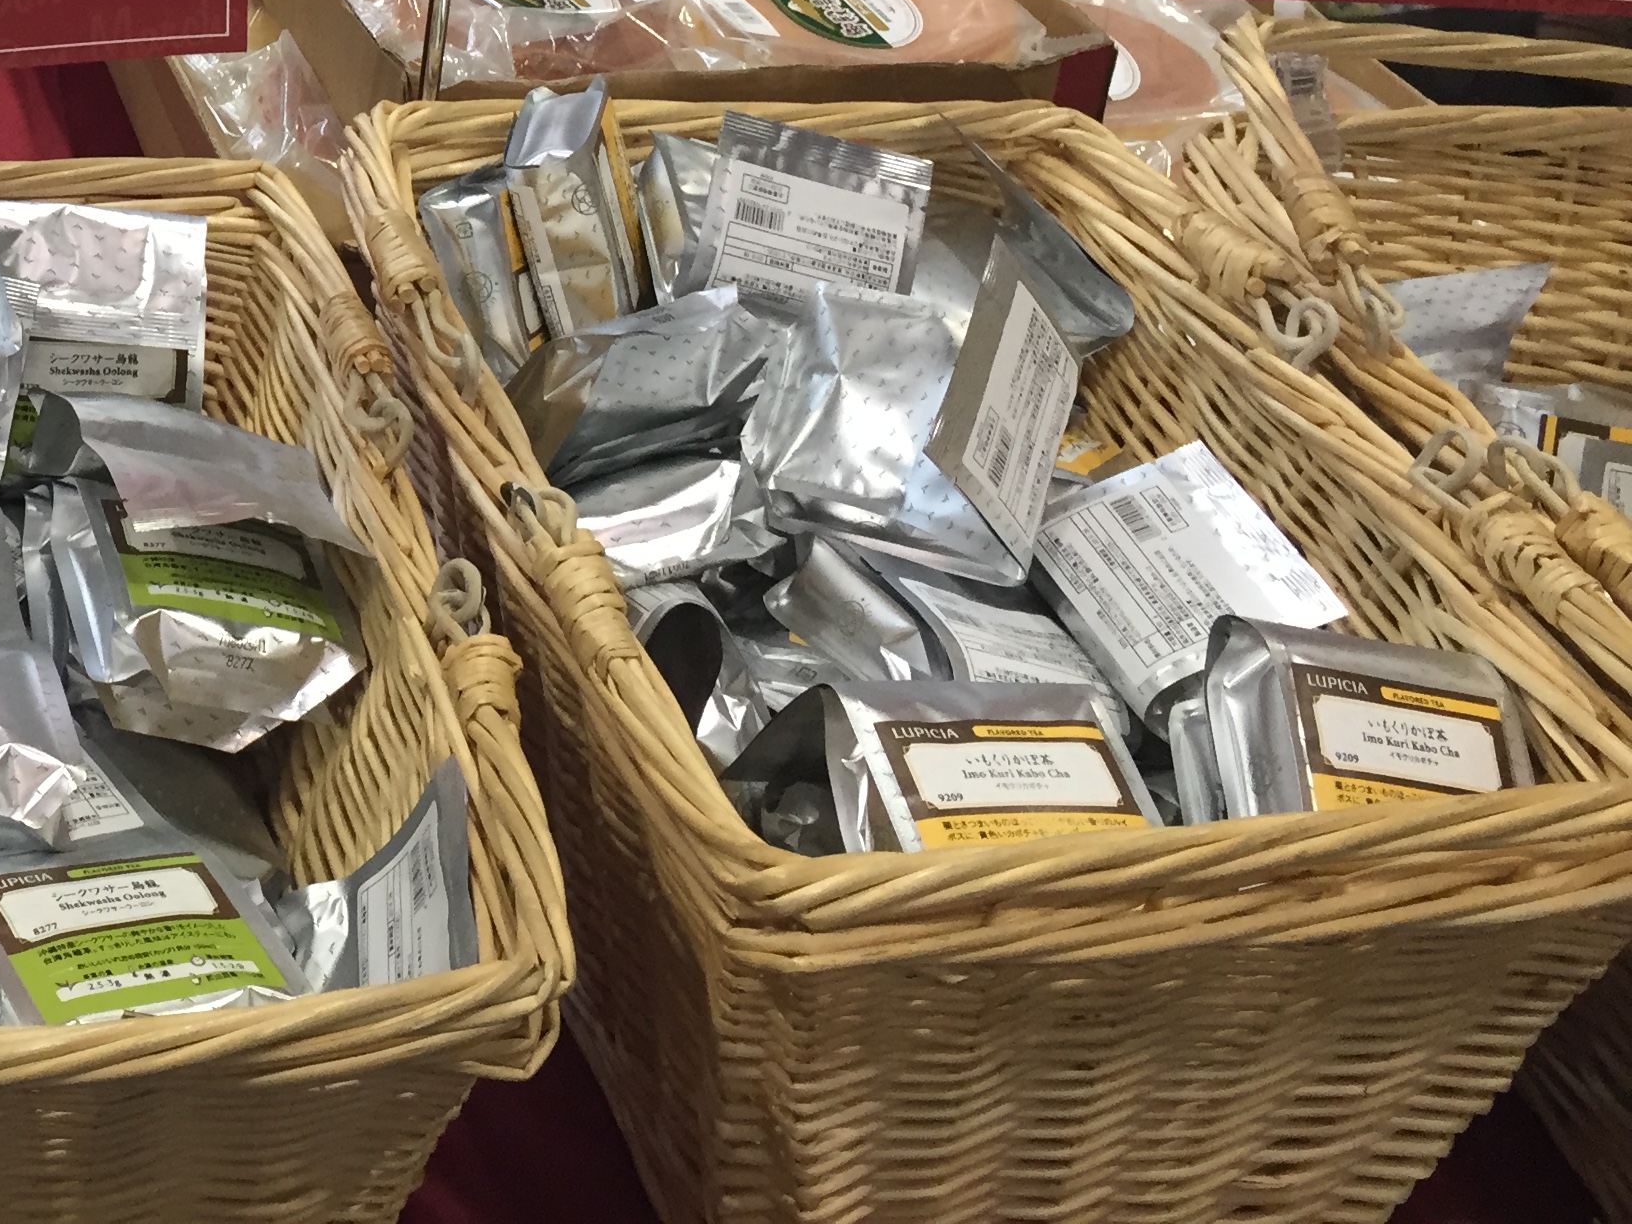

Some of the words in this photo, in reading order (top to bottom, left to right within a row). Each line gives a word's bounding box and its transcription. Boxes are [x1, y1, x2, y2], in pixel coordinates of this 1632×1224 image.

[48, 366, 101, 376] Shekwasha
[102, 366, 139, 378] Oolong
[1306, 672, 1368, 695] LUPICIA
[891, 726, 960, 740] LUPICIA
[1361, 732, 1384, 745] Imo
[1386, 736, 1410, 750] Kuri
[1411, 740, 1438, 755] Kabo
[1439, 745, 1461, 759] Cha
[1334, 751, 1360, 764] 9209
[962, 768, 987, 780] Imo
[989, 768, 1015, 779] Kuri
[1017, 768, 1046, 779] Kabo
[1048, 768, 1071, 779] Cha
[937, 792, 964, 802] 9209
[58, 893, 123, 911] Shekwasha
[122, 889, 168, 902] Oolong
[32, 922, 58, 936] 8277
